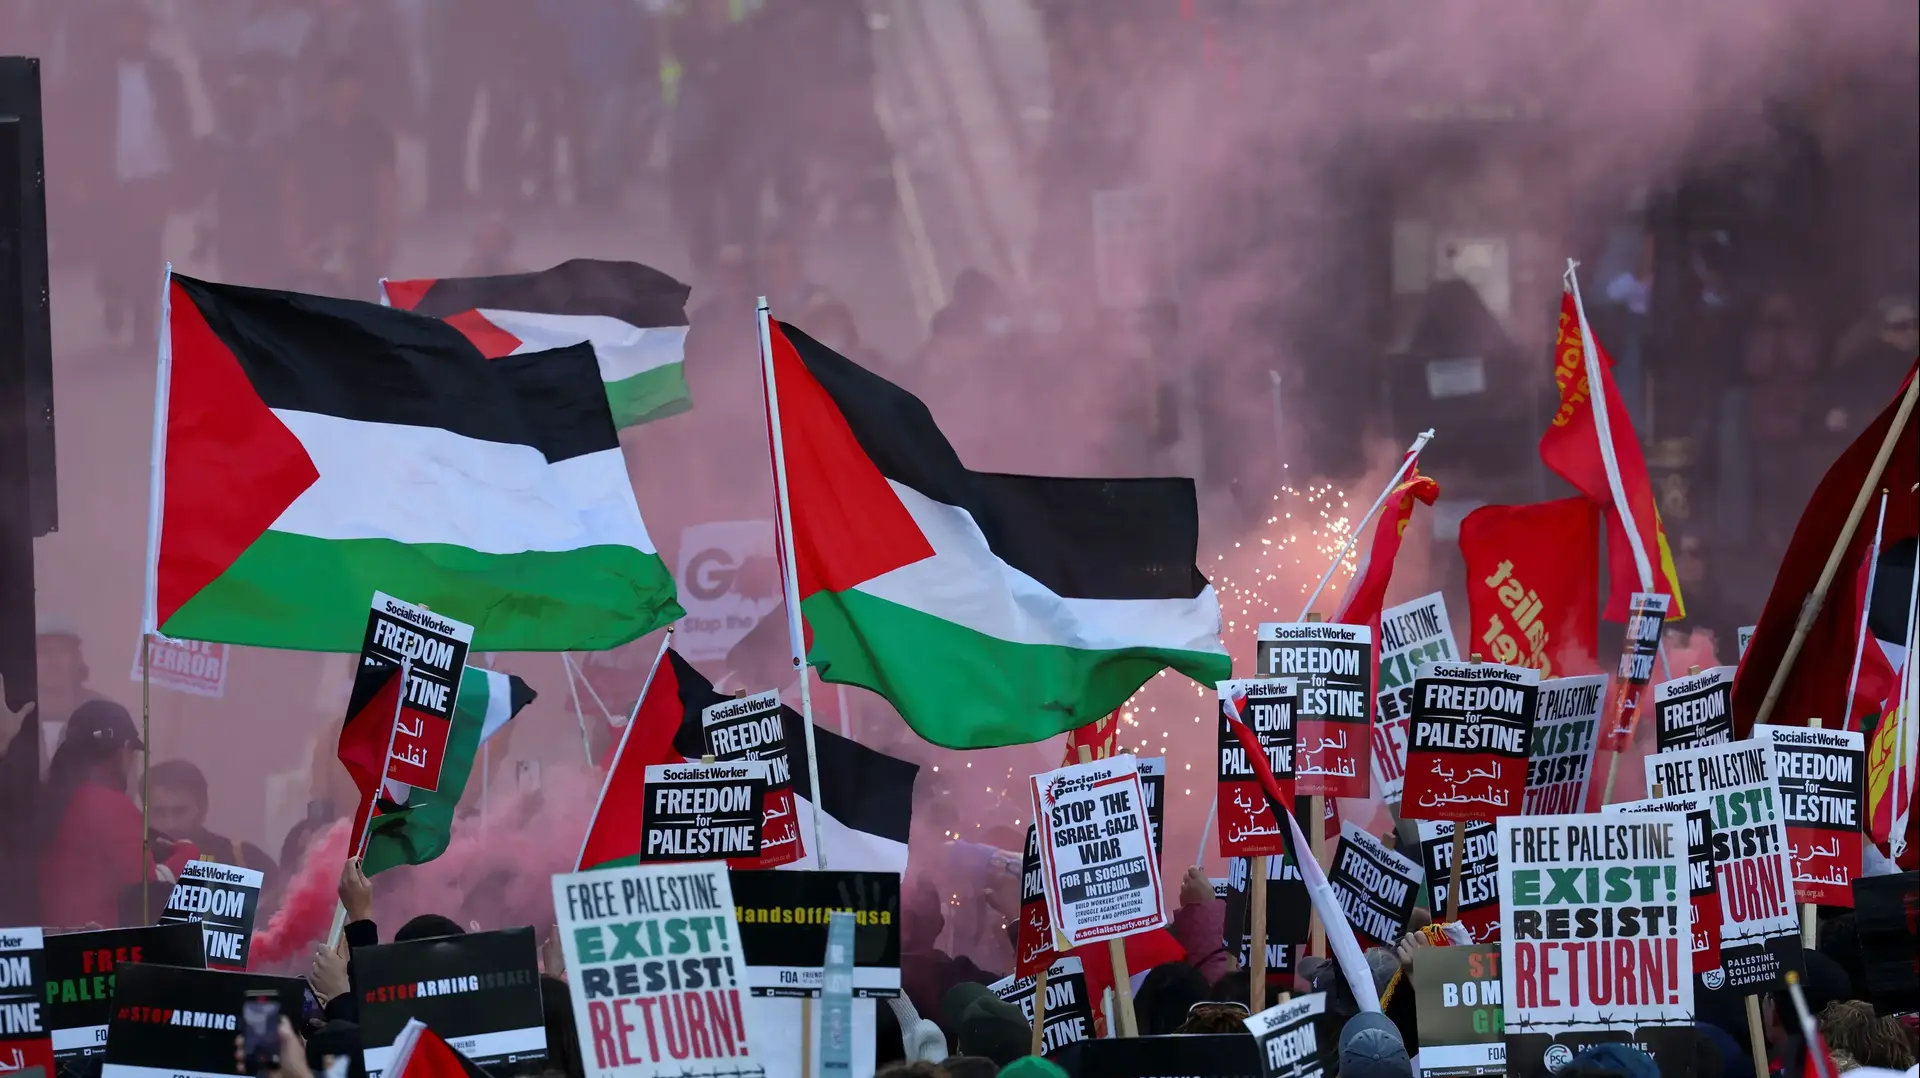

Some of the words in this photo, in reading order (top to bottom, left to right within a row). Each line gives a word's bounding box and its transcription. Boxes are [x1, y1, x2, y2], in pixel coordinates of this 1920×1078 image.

[373, 618, 455, 672] FREEDOM
[153, 647, 220, 680] ERROR
[1269, 647, 1360, 676] FREEDOM
[1311, 673, 1328, 687] for
[1424, 684, 1524, 715] FREEDOM
[1544, 684, 1602, 721] PALESTINE
[1663, 689, 1726, 732] FREEDOM
[1465, 711, 1482, 723] for
[1695, 724, 1706, 738] for
[711, 714, 784, 757] FREEDOM
[1415, 722, 1526, 753] PALESTINE
[745, 749, 760, 761] for
[1057, 770, 1112, 789] Socialist
[1431, 758, 1501, 784] الحرية
[1655, 759, 1696, 797] FREE
[1697, 748, 1769, 792] PALESTINE
[655, 785, 752, 815] FREEDOM
[1418, 785, 1509, 808] لفلسطين
[1804, 780, 1821, 793] for
[695, 814, 712, 827] for
[1051, 799, 1096, 828] STOP
[1099, 790, 1131, 817] THE
[647, 825, 755, 855] PALESTINE
[1054, 814, 1139, 848] ISRAEL-GAZA
[1511, 826, 1560, 863] FREE
[1567, 822, 1675, 862] PALESTINE
[1078, 837, 1122, 866] WAR
[1061, 873, 1080, 889] FOR
[1084, 873, 1092, 885] A
[1095, 859, 1146, 883] SOCIALIST
[1341, 847, 1409, 908] FREEDOM
[1472, 863, 1486, 875] for
[567, 881, 619, 922] FREE
[622, 874, 722, 915] PALESTINE
[1085, 877, 1131, 898] INTIFADA
[1360, 887, 1371, 903] for
[1512, 865, 1677, 906] EXIST!
[1075, 902, 1089, 910] BUILD
[1117, 893, 1129, 902] UNITY
[1130, 891, 1141, 899] AND
[1075, 909, 1099, 918] STRUGGLE
[1100, 905, 1120, 913] AGAINST
[1121, 899, 1143, 909] NATIONAL
[1331, 881, 1402, 946] PALESTINE
[1077, 916, 1101, 925] CONFLICT
[1102, 912, 1113, 921] AND
[1113, 907, 1141, 917] OPPRESSION
[1513, 905, 1678, 940] RESIST!
[573, 916, 730, 965] EXIST!
[82, 946, 143, 975] FREE
[1515, 937, 1679, 1009] RETURN!
[1727, 953, 1775, 968] PALESTINE
[1729, 961, 1780, 977] SOLIDARITY
[581, 956, 737, 999] RESIST!
[780, 971, 798, 984] FOA
[1706, 971, 1721, 982] PSC
[1730, 971, 1776, 986] CAMPAIGN
[588, 989, 749, 1070] RETURN!
[1266, 1021, 1318, 1071] FREEDOM
[1550, 1054, 1567, 1065] PSC
